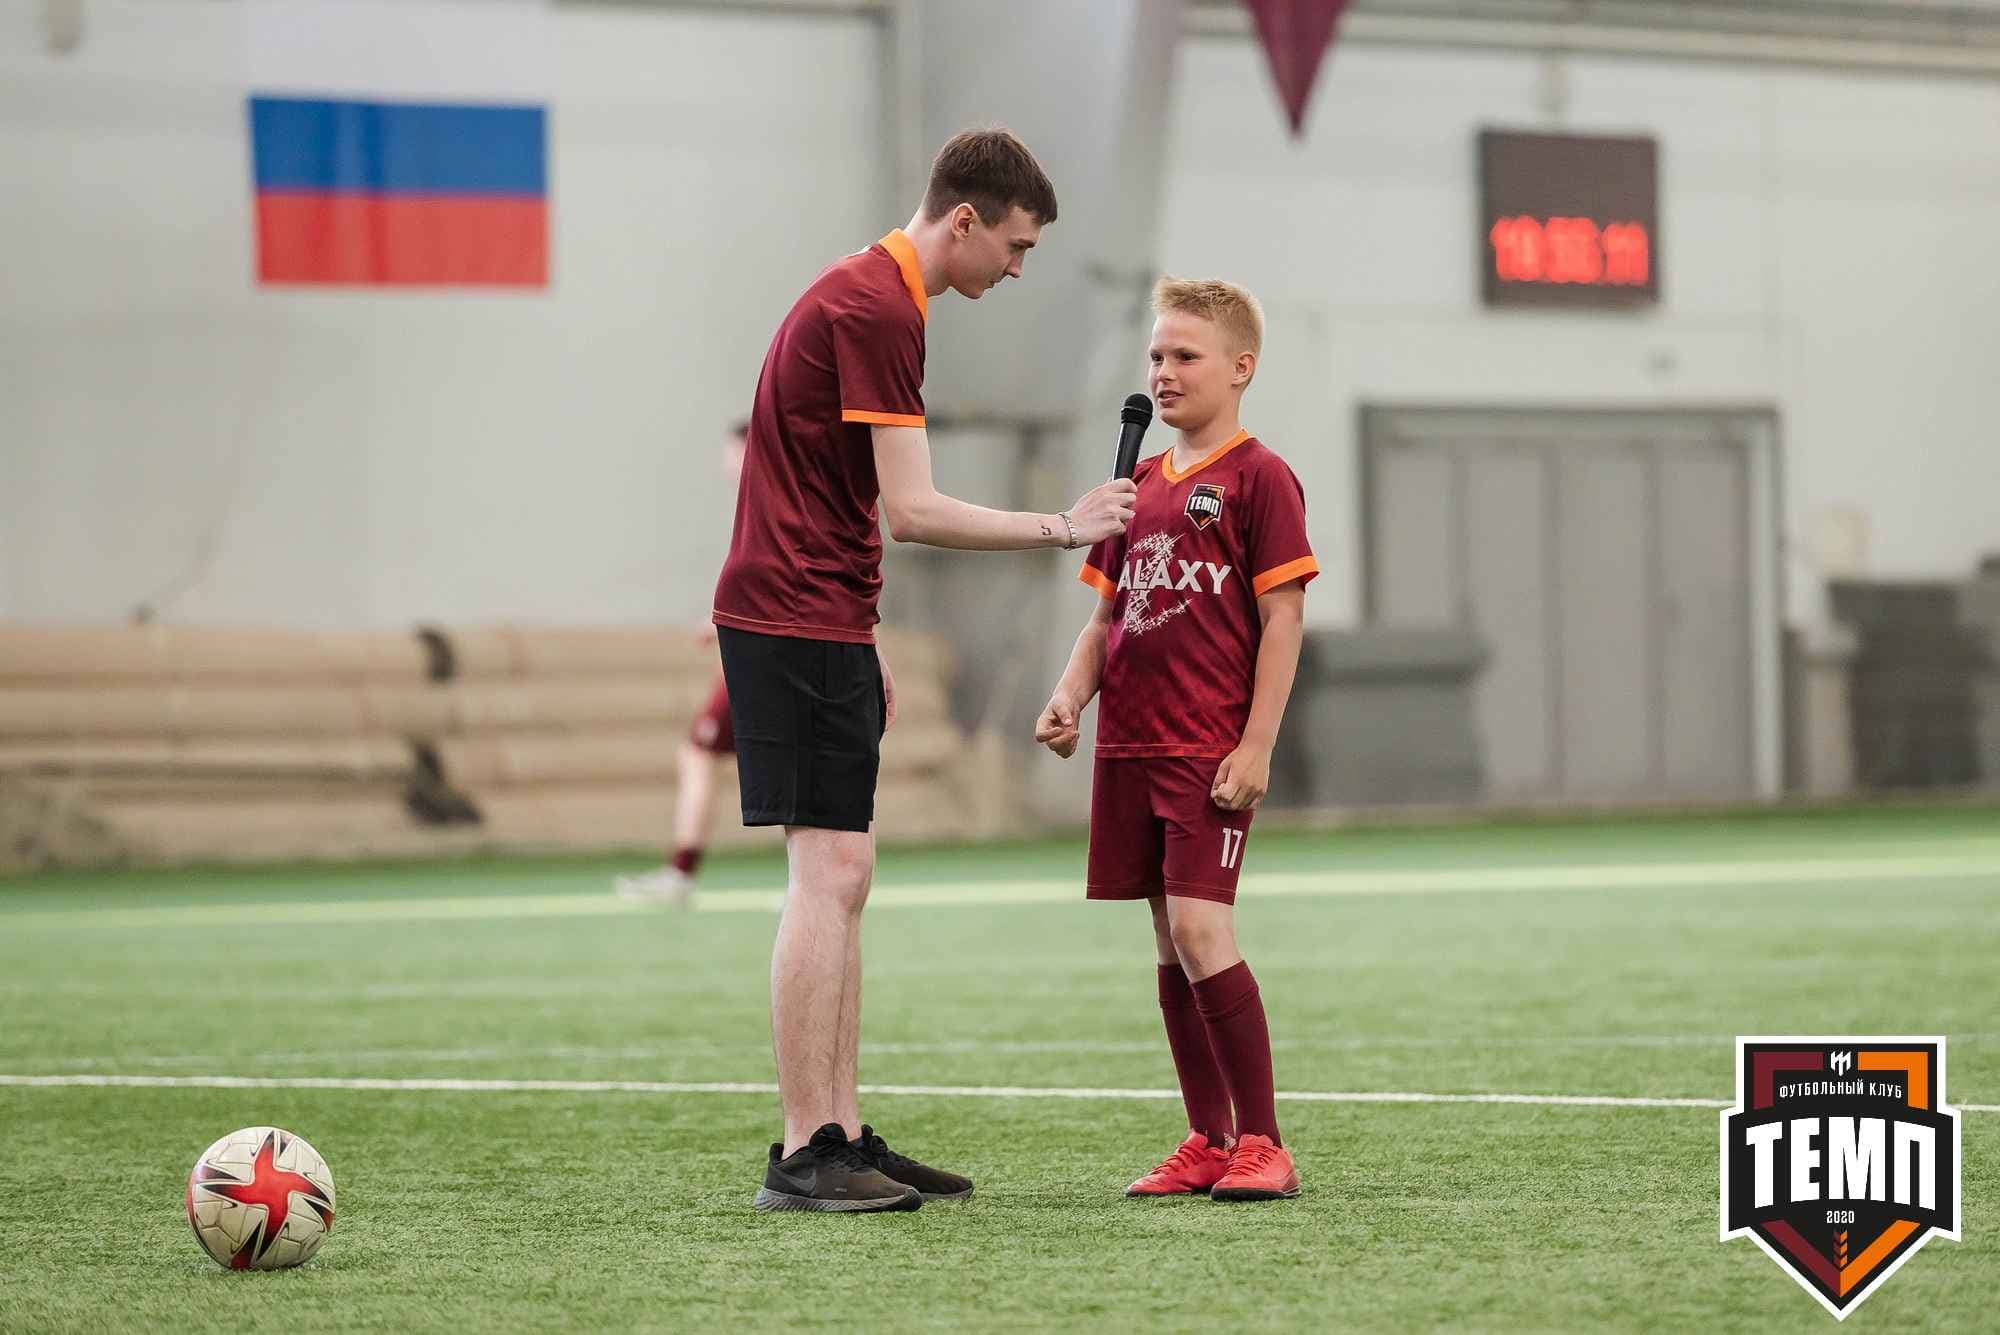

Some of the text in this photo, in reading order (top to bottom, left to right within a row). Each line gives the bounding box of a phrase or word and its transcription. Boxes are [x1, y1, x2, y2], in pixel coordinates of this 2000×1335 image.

[1189, 495, 1220, 516] ТЕМП
[1116, 558, 1232, 595] ALAXY
[1221, 828, 1243, 868] 17
